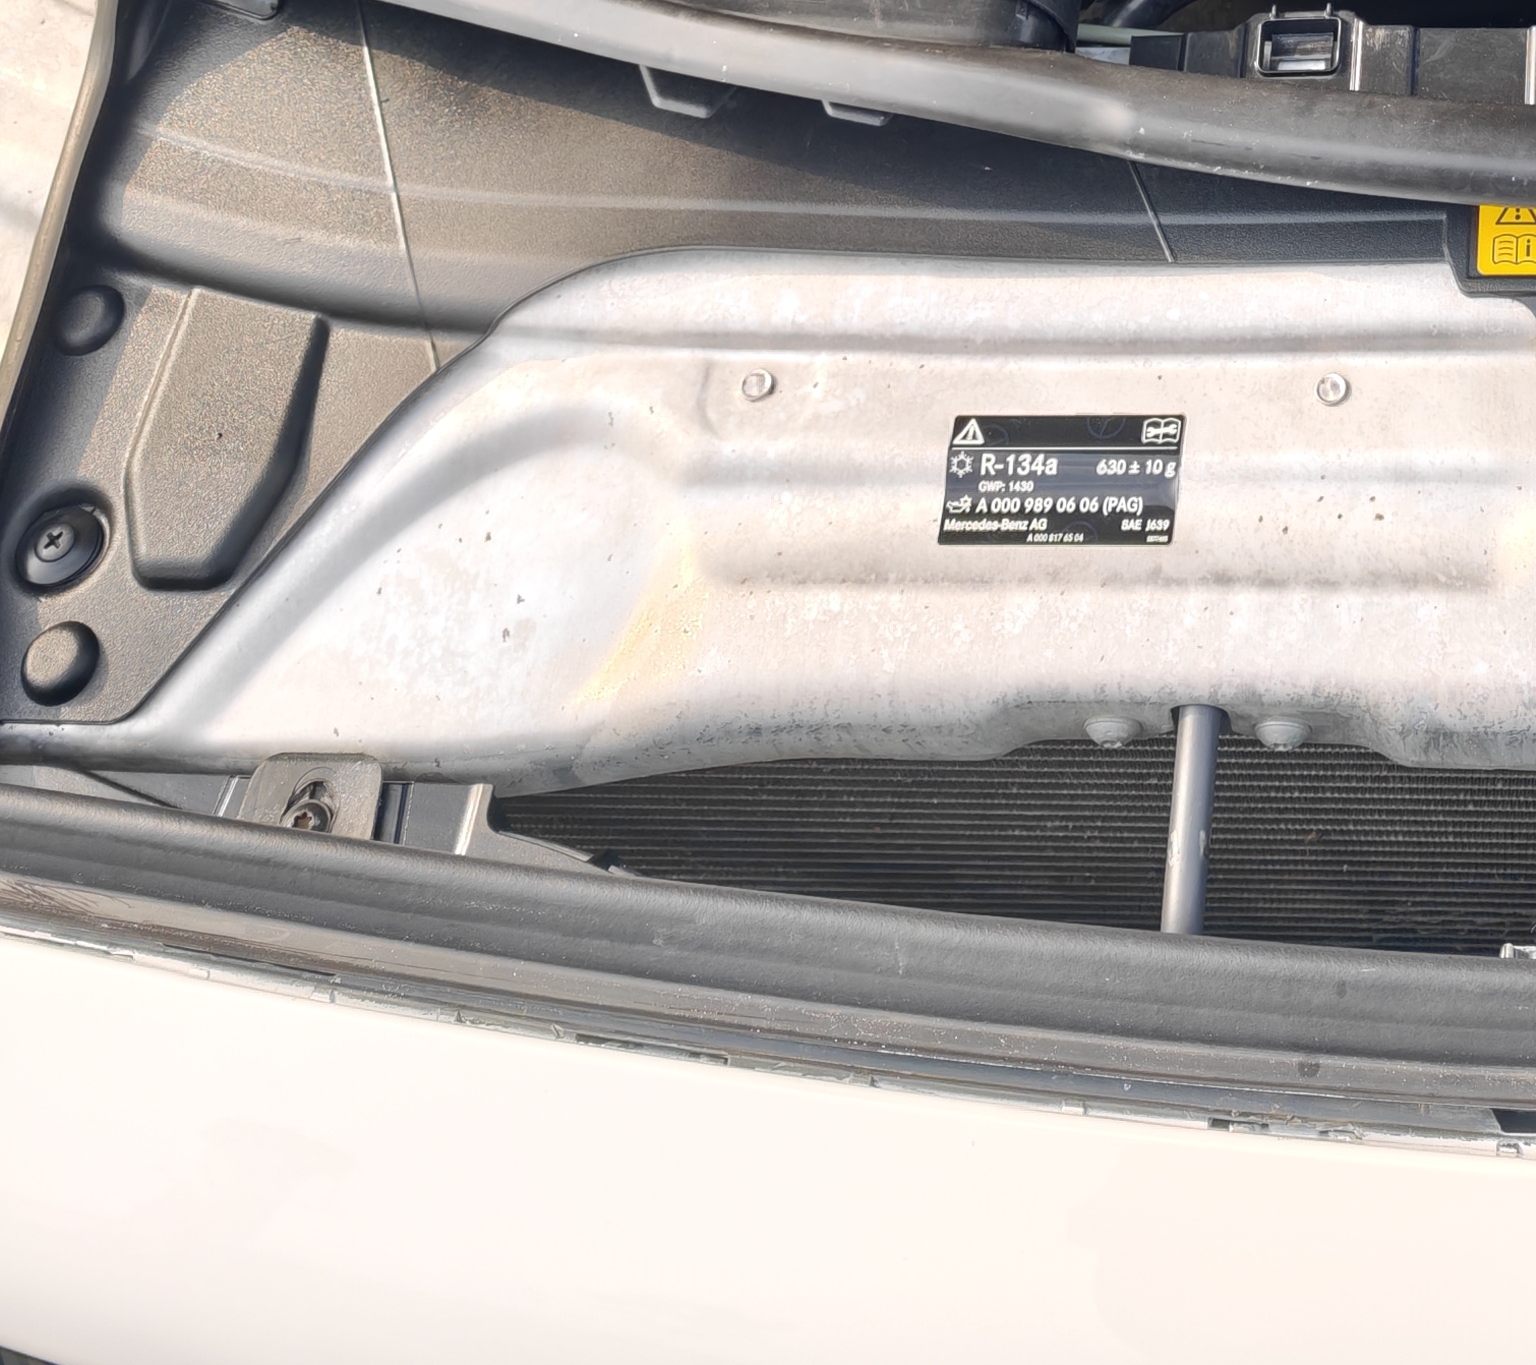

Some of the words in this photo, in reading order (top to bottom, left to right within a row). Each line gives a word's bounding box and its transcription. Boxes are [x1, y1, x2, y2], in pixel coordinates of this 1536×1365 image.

[980, 453, 1058, 476] R-134a
[1096, 459, 1126, 475] 630
[1145, 459, 1163, 475] 10
[1164, 461, 1177, 478] g
[978, 480, 1006, 493] GWP:
[975, 497, 988, 513] A
[990, 497, 1021, 513] 000
[1024, 497, 1053, 513] 989
[1056, 497, 1077, 513] 06
[1079, 497, 1099, 513] 06
[1102, 496, 1144, 516] (PAG)
[943, 518, 1029, 532] Mercedes-Benz
[1029, 518, 1048, 531] AG
[1121, 519, 1142, 531] SAE
